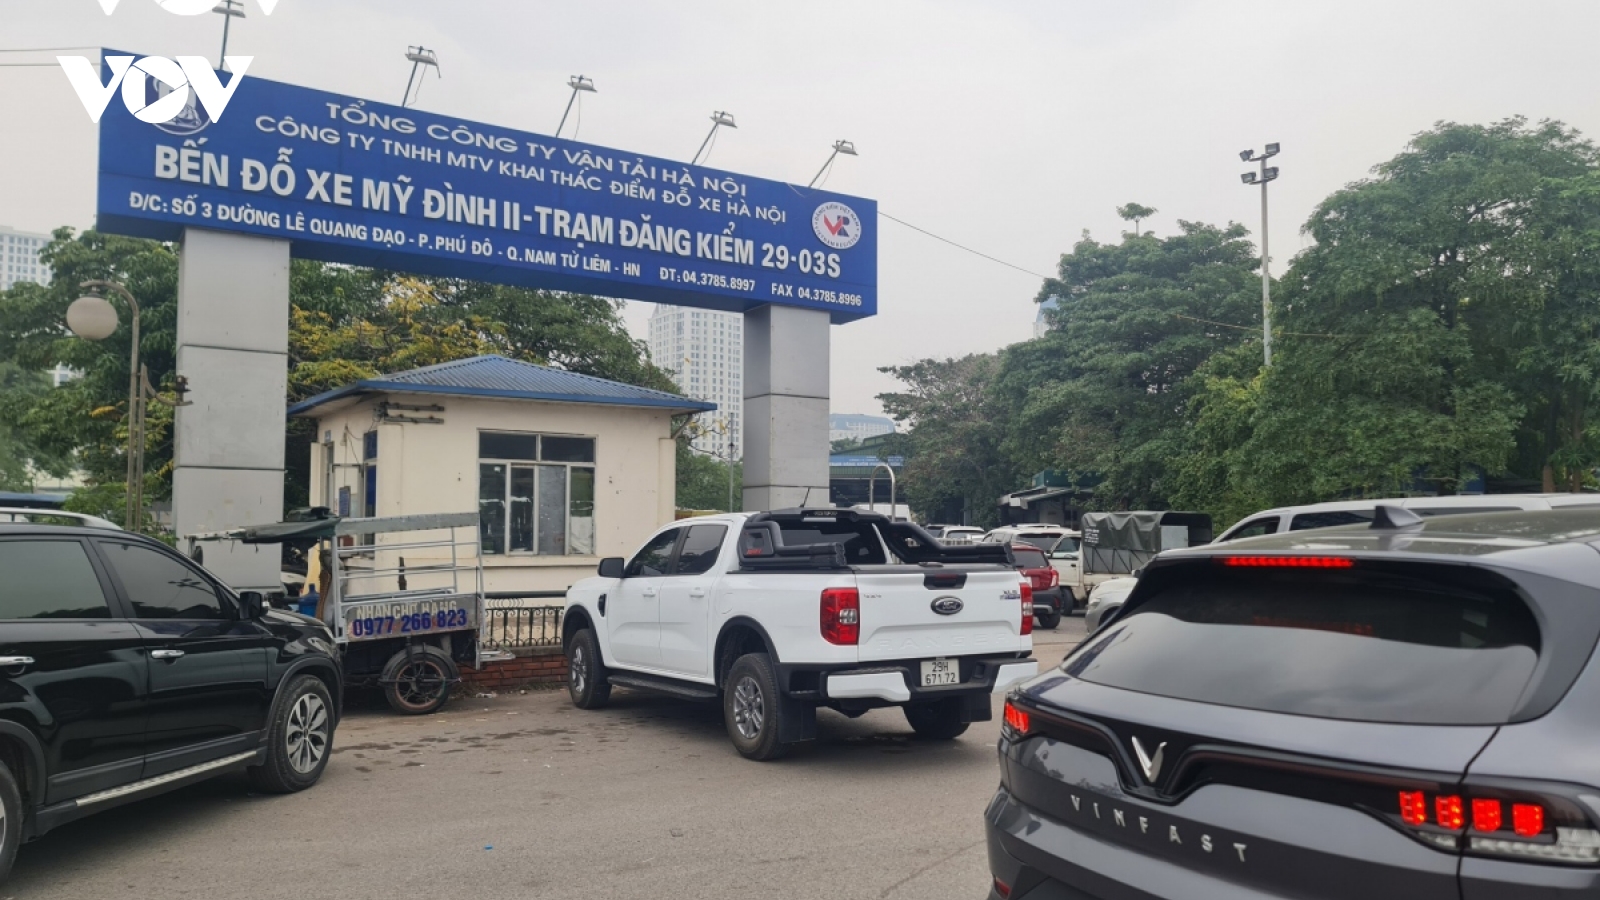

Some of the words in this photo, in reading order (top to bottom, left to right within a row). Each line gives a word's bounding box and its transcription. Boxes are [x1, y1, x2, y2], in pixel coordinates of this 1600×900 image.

[255, 115, 341, 145] CÔNG
[347, 132, 375, 150] TY
[381, 138, 441, 164] TNHH
[447, 150, 494, 172] MTV
[499, 160, 545, 182] KHAI
[550, 168, 602, 191] THÁC
[609, 177, 656, 201] ĐIỂM
[661, 187, 692, 207] ĐỖ
[699, 196, 721, 213] XE
[727, 199, 751, 218] HÀ
[756, 205, 786, 226] NỘI
[326, 100, 416, 134] TỔNG
[427, 124, 518, 153] CÔNG
[526, 142, 556, 160] TY
[563, 149, 613, 172] VẬN
[619, 157, 656, 180] TẢI
[662, 167, 696, 188] HÀ
[703, 177, 746, 198] NỘI
[155, 137, 229, 188] BẾN
[240, 146, 296, 197] ĐỖ
[305, 168, 353, 206] XE
[362, 174, 415, 215] MỸ
[423, 181, 497, 228] ĐÌNH
[618, 213, 691, 257] ĐĂNG
[696, 221, 754, 266] KIỂM
[129, 191, 168, 213] Đ/C:
[171, 193, 198, 217] SỐ
[201, 202, 213, 218] 3
[217, 202, 281, 229] ĐƯỜNG
[286, 211, 305, 231] LÊ
[310, 218, 368, 241] QUANG
[372, 226, 405, 248] ĐẠO
[471, 237, 493, 257] ĐÔ
[560, 250, 580, 268] TỪ
[583, 253, 611, 274] LIÊM
[623, 262, 641, 277] HN
[771, 282, 793, 298] FAX
[798, 286, 862, 307] 04.3785.8996
[352, 616, 395, 636] 0977
[400, 612, 432, 632] 266
[436, 608, 467, 628] 823
[879, 633, 1010, 648] RANGER
[925, 673, 956, 685] 671.72
[932, 661, 949, 672] 29H
[1070, 794, 1247, 863] VINFAST
